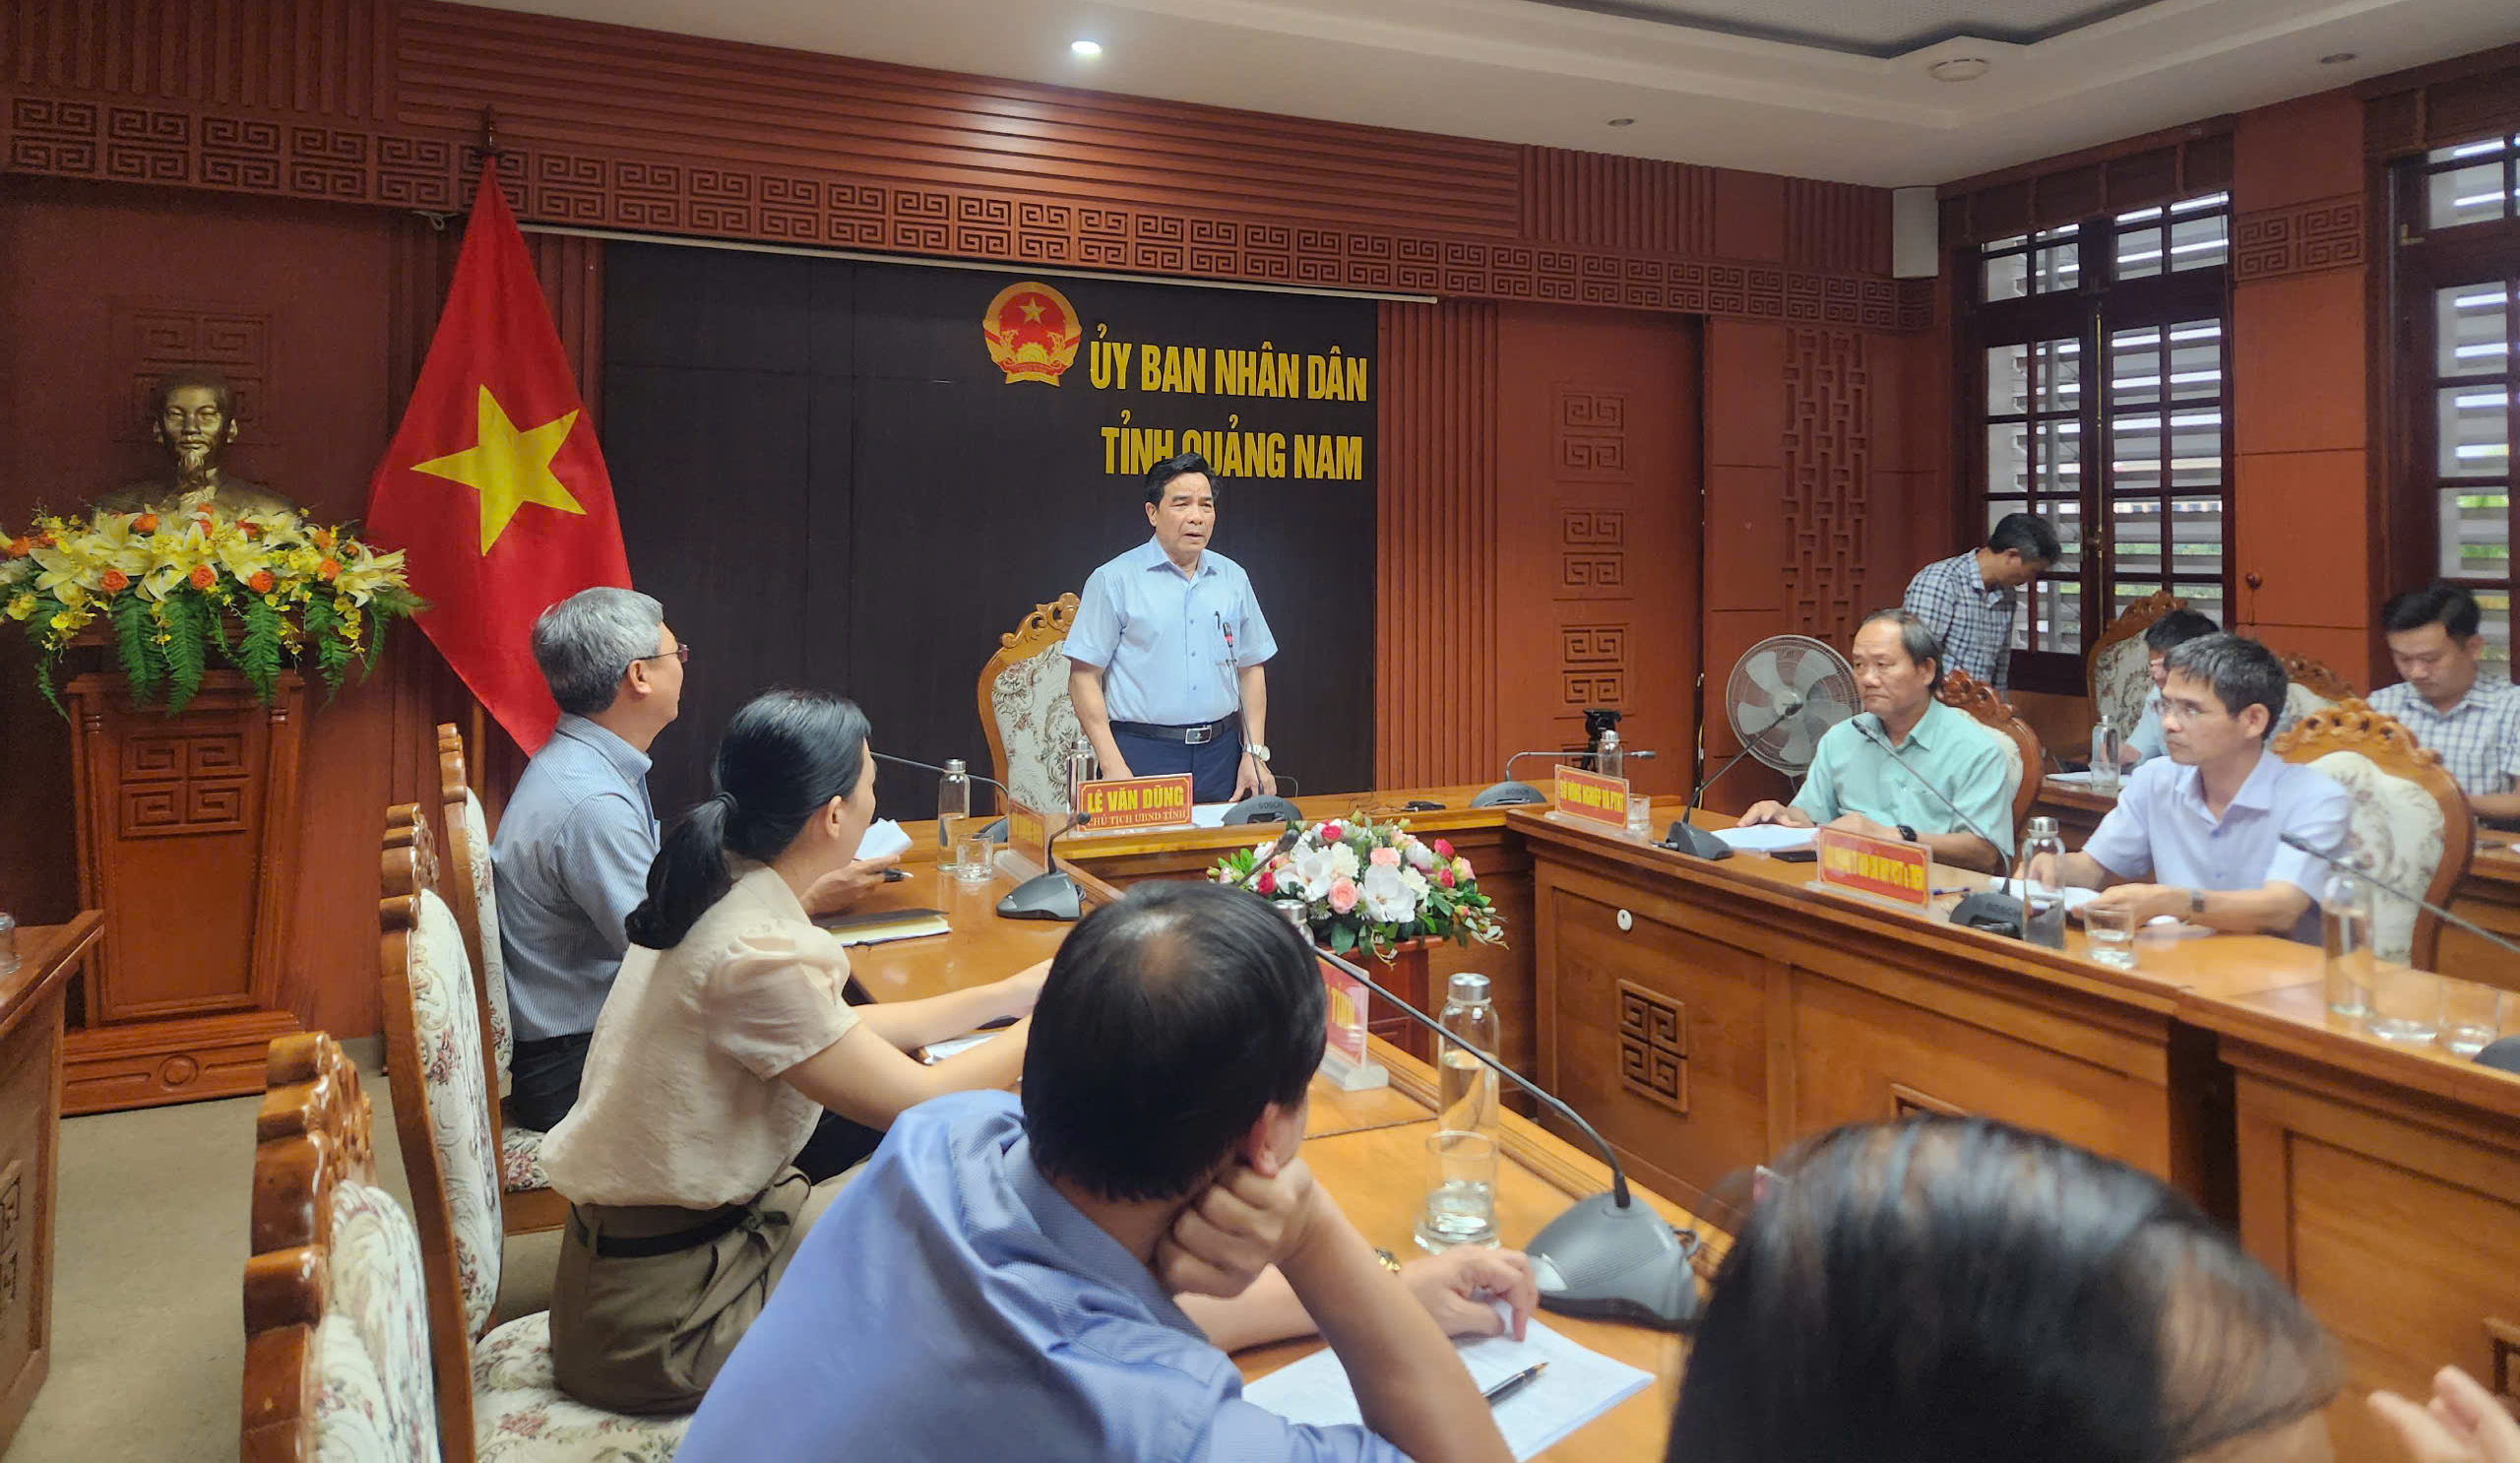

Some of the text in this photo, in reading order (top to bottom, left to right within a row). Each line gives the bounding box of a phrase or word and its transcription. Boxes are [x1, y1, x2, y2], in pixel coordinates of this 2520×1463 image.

[1090, 323, 1367, 402] ỦY BAN NHÂN DÂN
[1101, 409, 1173, 475] TỈNH
[1293, 434, 1363, 480] NAM
[1087, 785, 1184, 813] LÊ VĂN DŨNG
[1110, 814, 1132, 826] TỊCH
[1135, 811, 1162, 822] UBND
[1164, 808, 1186, 820] TỈNH
